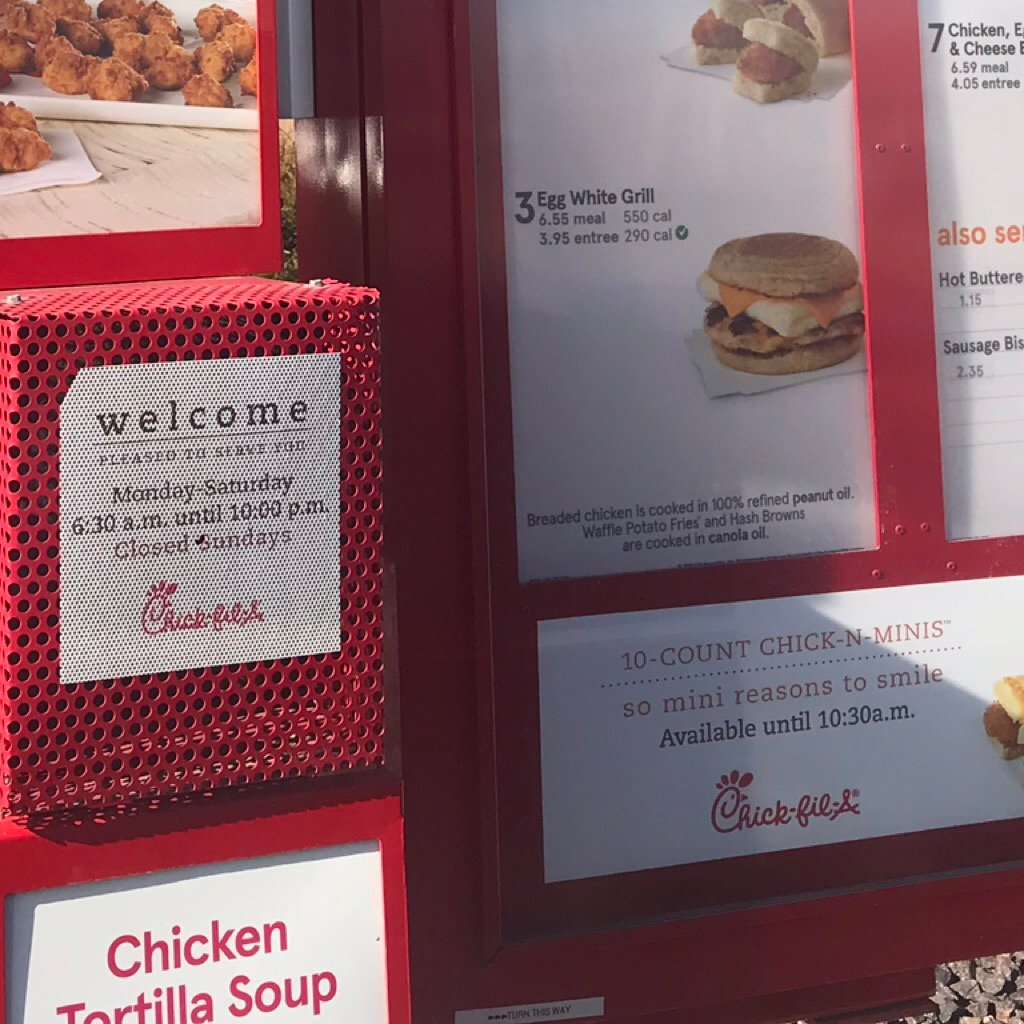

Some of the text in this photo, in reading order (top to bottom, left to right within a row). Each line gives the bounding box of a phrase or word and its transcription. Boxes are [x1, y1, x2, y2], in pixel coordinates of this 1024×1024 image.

[515, 188, 654, 224] 3 Egg White Grill
[96, 399, 309, 437] welcome
[71, 499, 329, 535] 6:30 a.m. until 10:00 p.m.
[115, 528, 292, 560] Closed Sundays
[623, 527, 769, 552] are cooked in canola oil.
[621, 641, 750, 671] 10-COUNT
[624, 665, 944, 717] so mini reasons to smile
[659, 705, 915, 748] Available until 10:30a.m.
[108, 920, 287, 978] Chicken
[229, 972, 337, 1017] Soup
[507, 1005, 571, 1020] TURN THIS WAY
